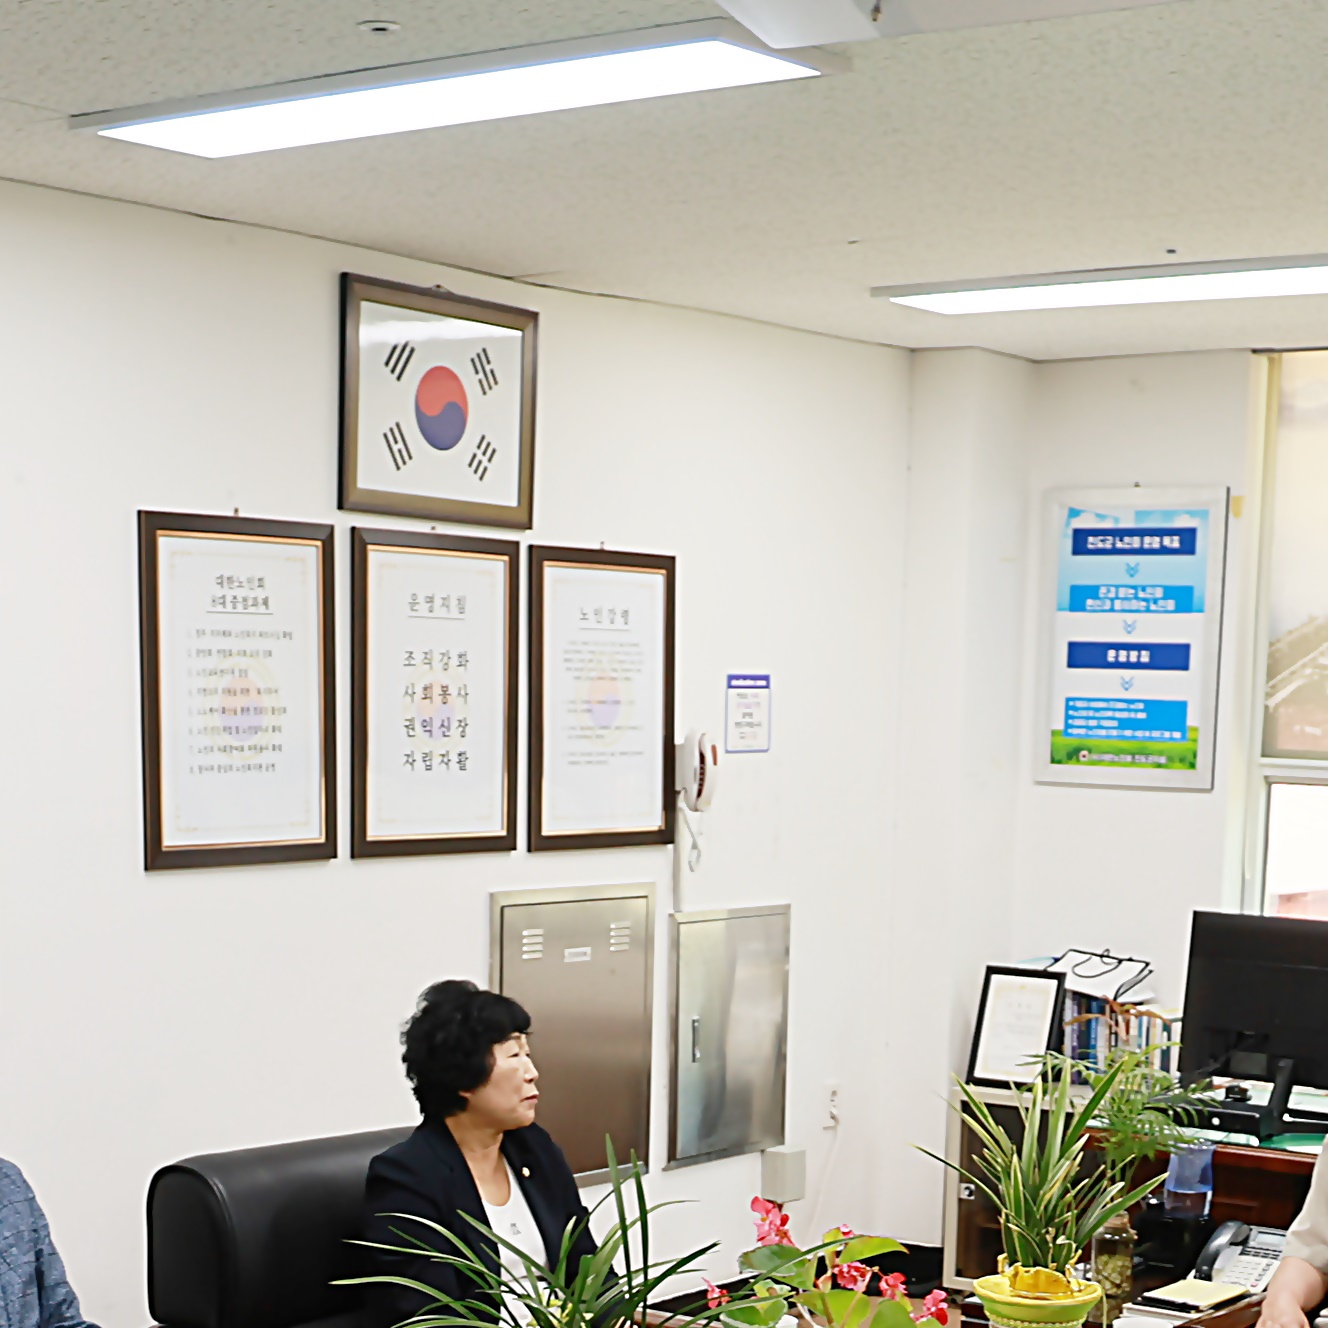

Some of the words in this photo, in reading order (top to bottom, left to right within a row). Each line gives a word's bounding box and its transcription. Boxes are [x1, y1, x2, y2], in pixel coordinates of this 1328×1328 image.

[215, 574, 266, 591] 대한노인회
[403, 649, 470, 671] 조직강화
[403, 683, 470, 704] 사회봉사
[403, 717, 470, 738] 권익신장
[403, 750, 470, 771] 자립자활
